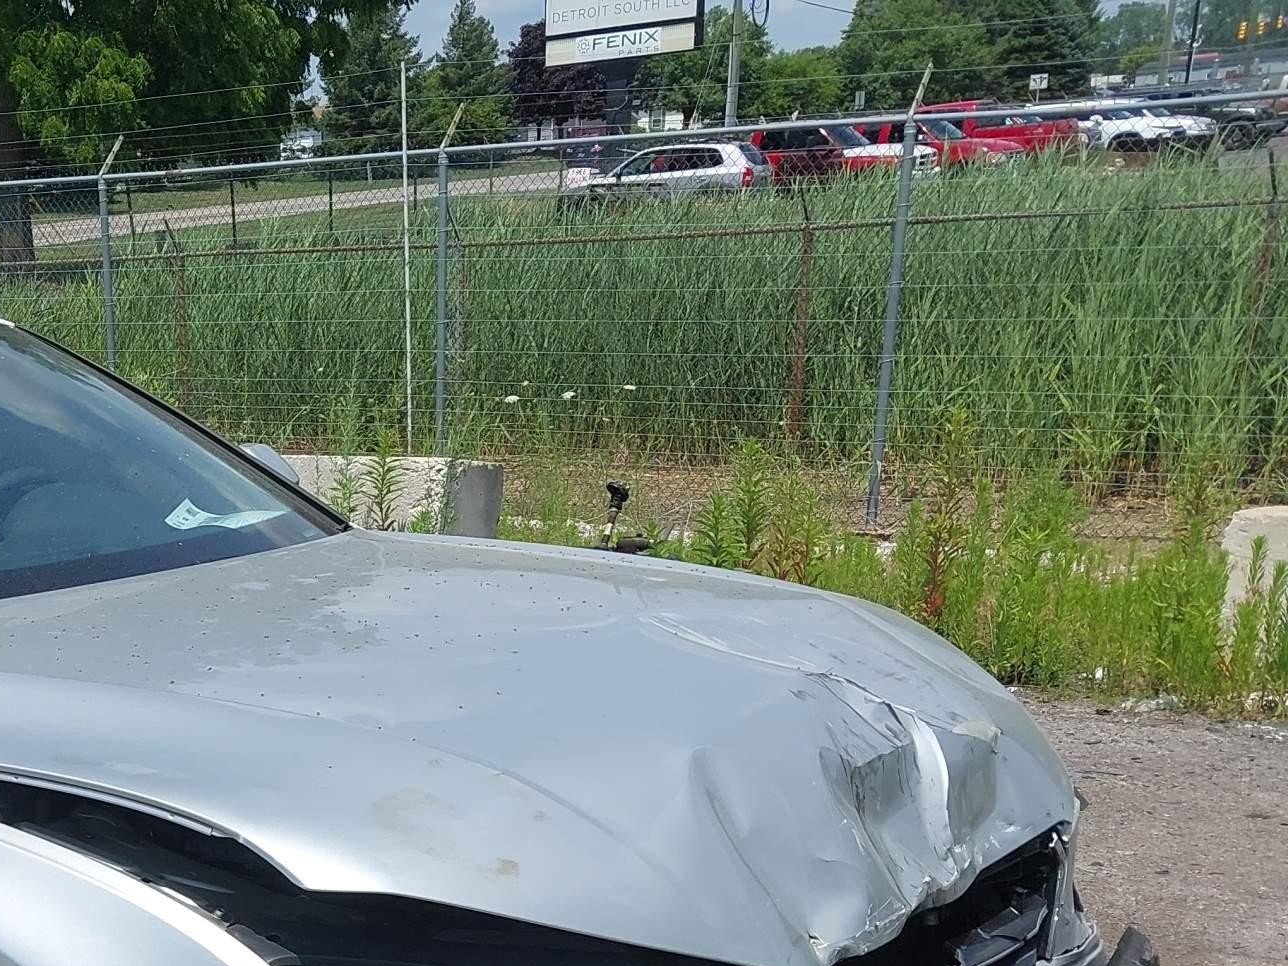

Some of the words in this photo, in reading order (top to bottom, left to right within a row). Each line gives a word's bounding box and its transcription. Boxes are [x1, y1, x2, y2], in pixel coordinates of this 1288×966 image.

[552, 5, 609, 24] DETROIT
[614, 0, 660, 15] SOUTH
[592, 29, 659, 51] FENIX
[618, 45, 660, 57] PARTS
